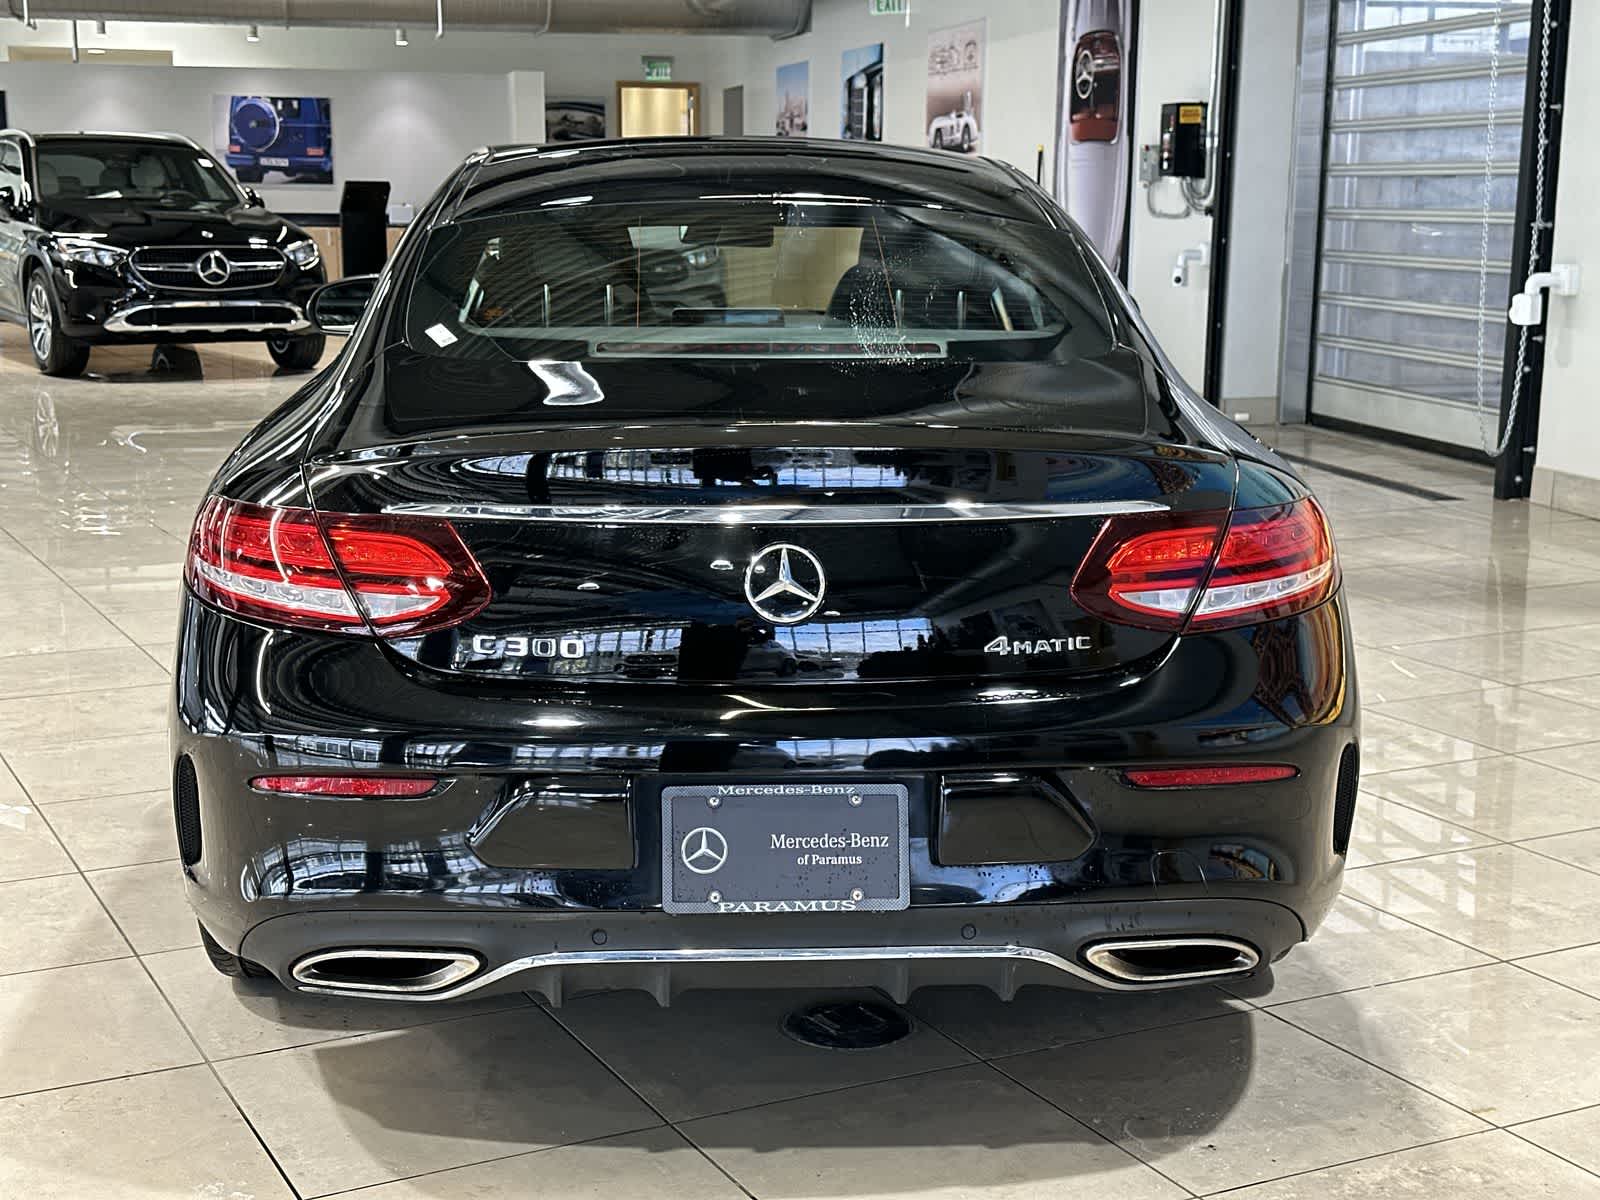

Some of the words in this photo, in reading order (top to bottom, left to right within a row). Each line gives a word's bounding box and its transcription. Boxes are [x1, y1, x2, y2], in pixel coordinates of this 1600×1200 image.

[984, 636, 1092, 655] 4MATIC
[718, 785, 856, 796] Mercedes-Benz
[771, 832, 889, 849] Mercedes-Benz
[797, 854, 810, 865] of
[812, 854, 862, 865] Paramus
[717, 899, 857, 912] PARAMUS
